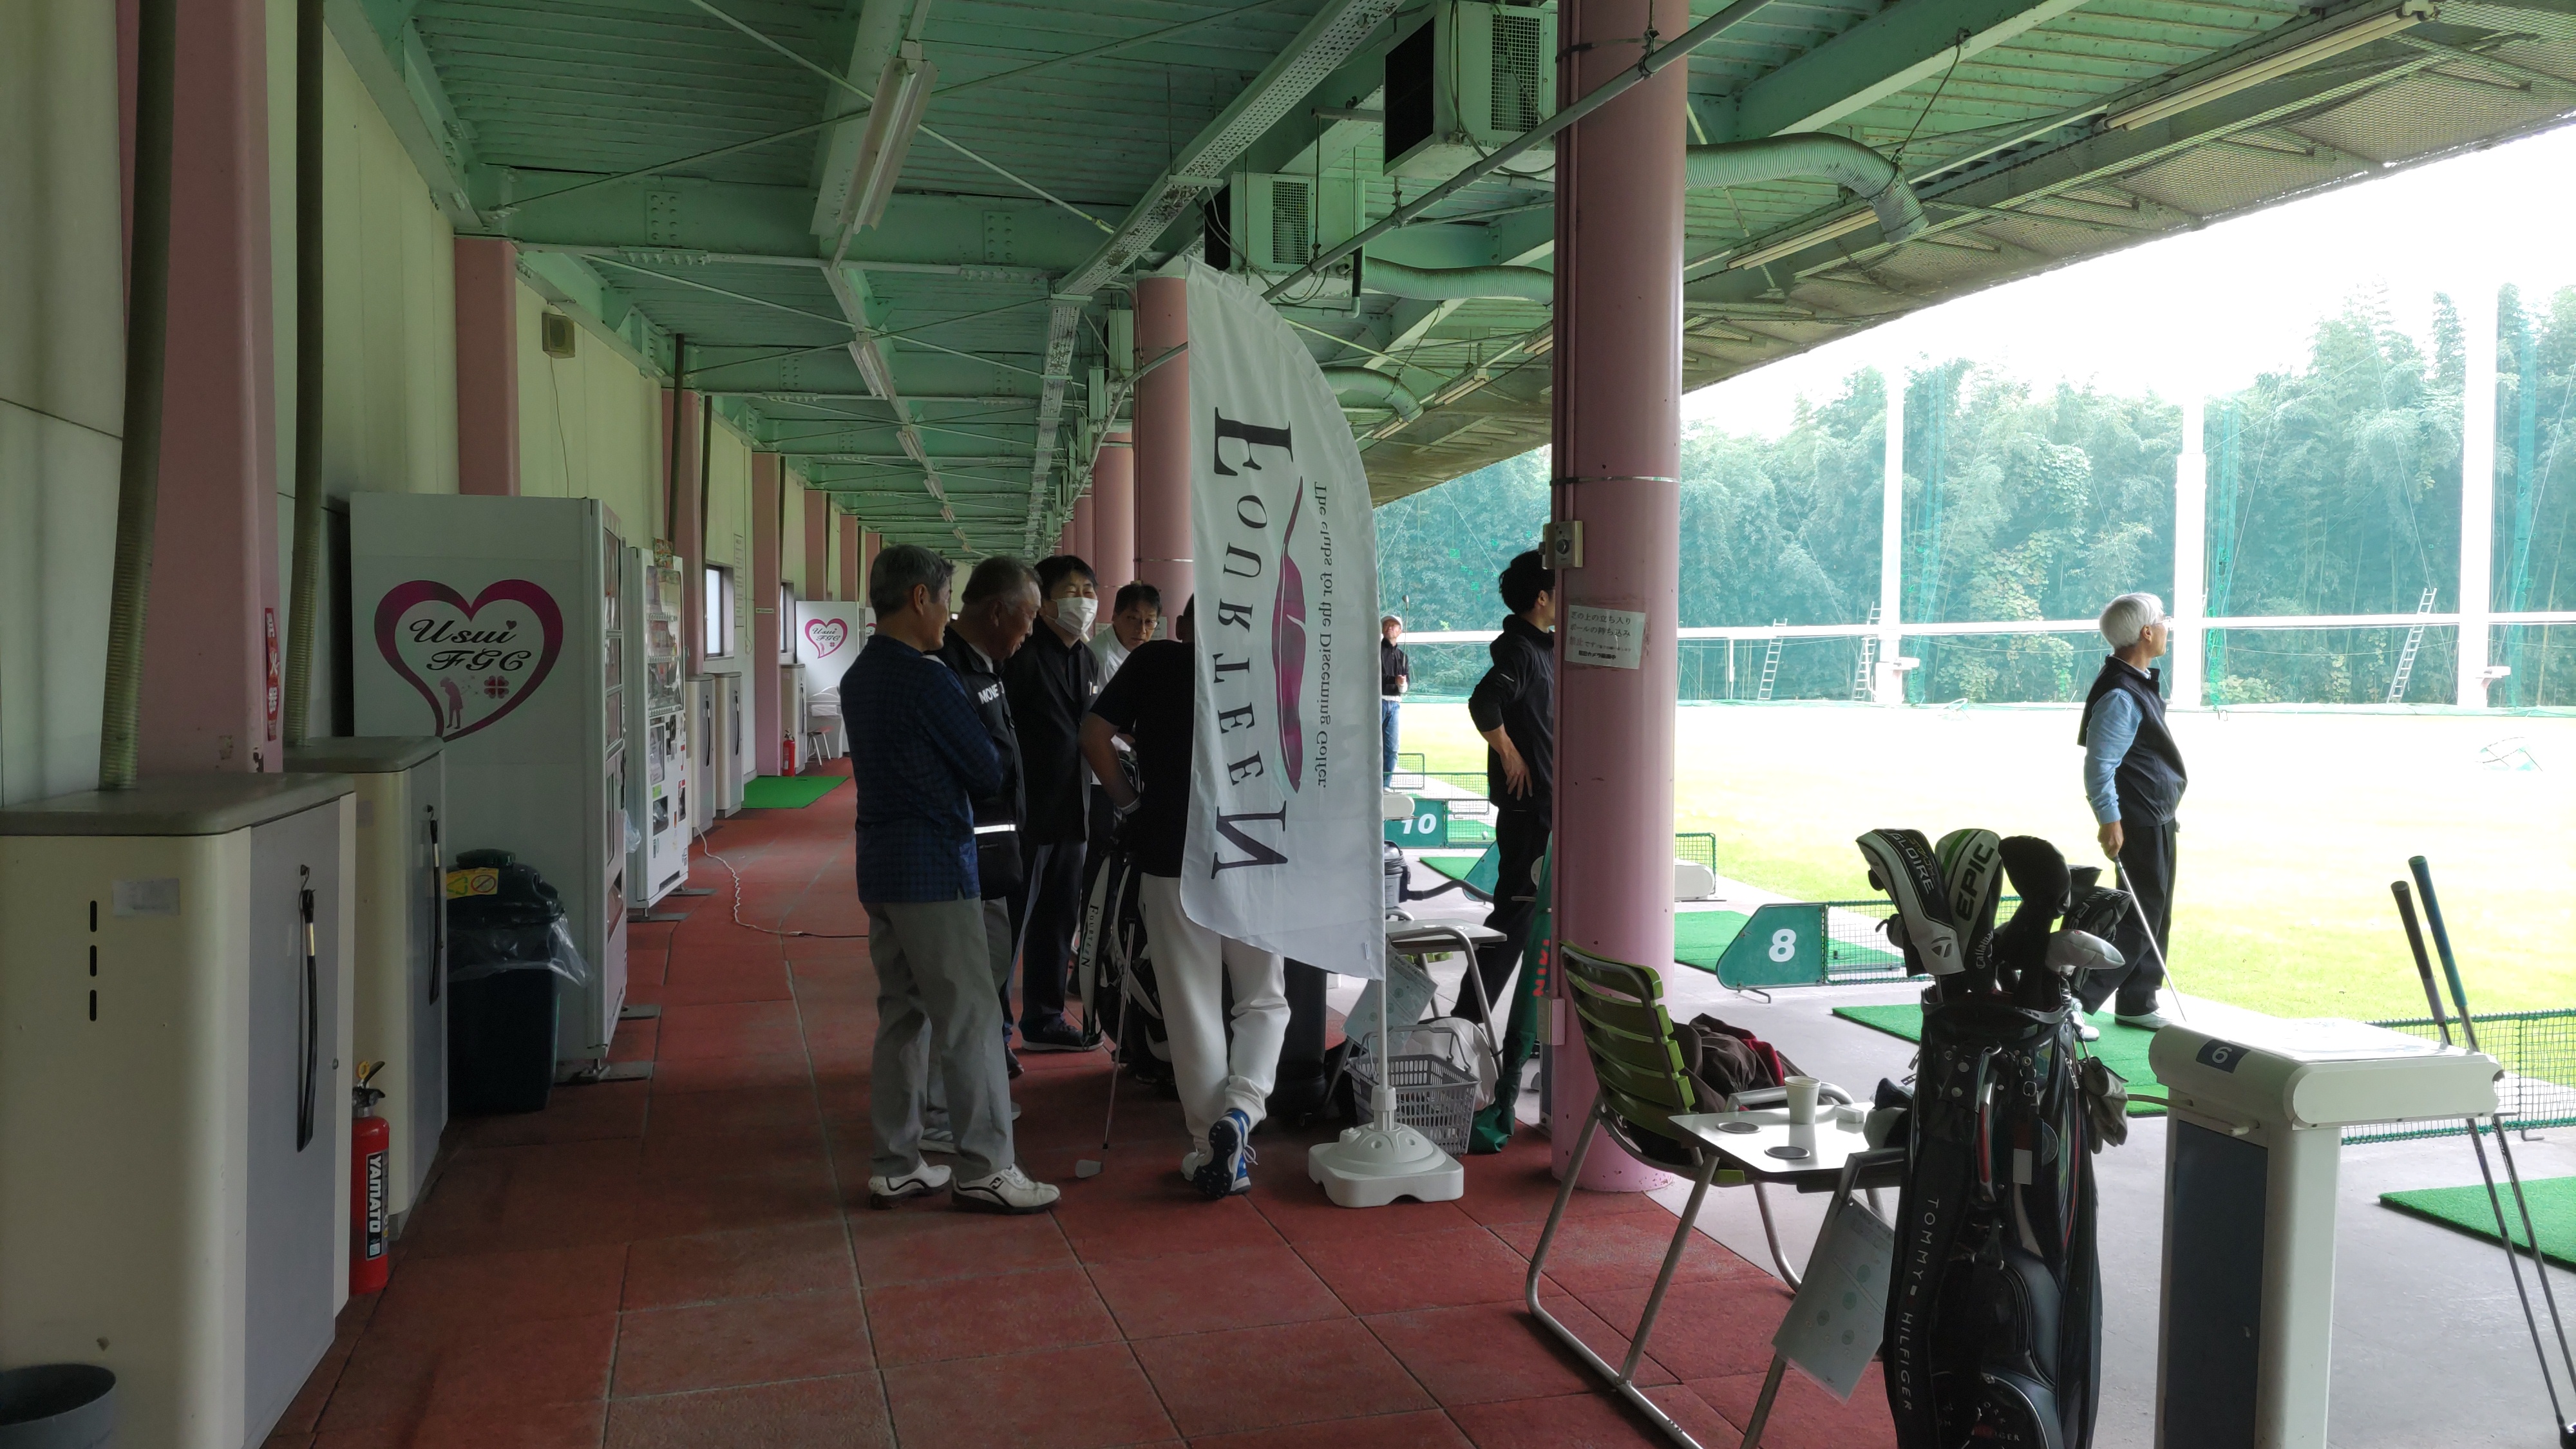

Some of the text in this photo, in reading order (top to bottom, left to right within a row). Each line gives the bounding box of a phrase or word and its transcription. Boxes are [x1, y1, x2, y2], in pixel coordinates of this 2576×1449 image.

[409, 619, 517, 643] Usui
[1401, 813, 1437, 835] 10
[1886, 833, 1935, 895] GLOIRE
[1955, 843, 1995, 922] EPIC
[1768, 928, 1796, 963] 8
[2211, 1046, 2233, 1064] 6
[369, 1155, 382, 1233] YAMATO
[1900, 1197, 1940, 1410] TOMMY HILFIGER
